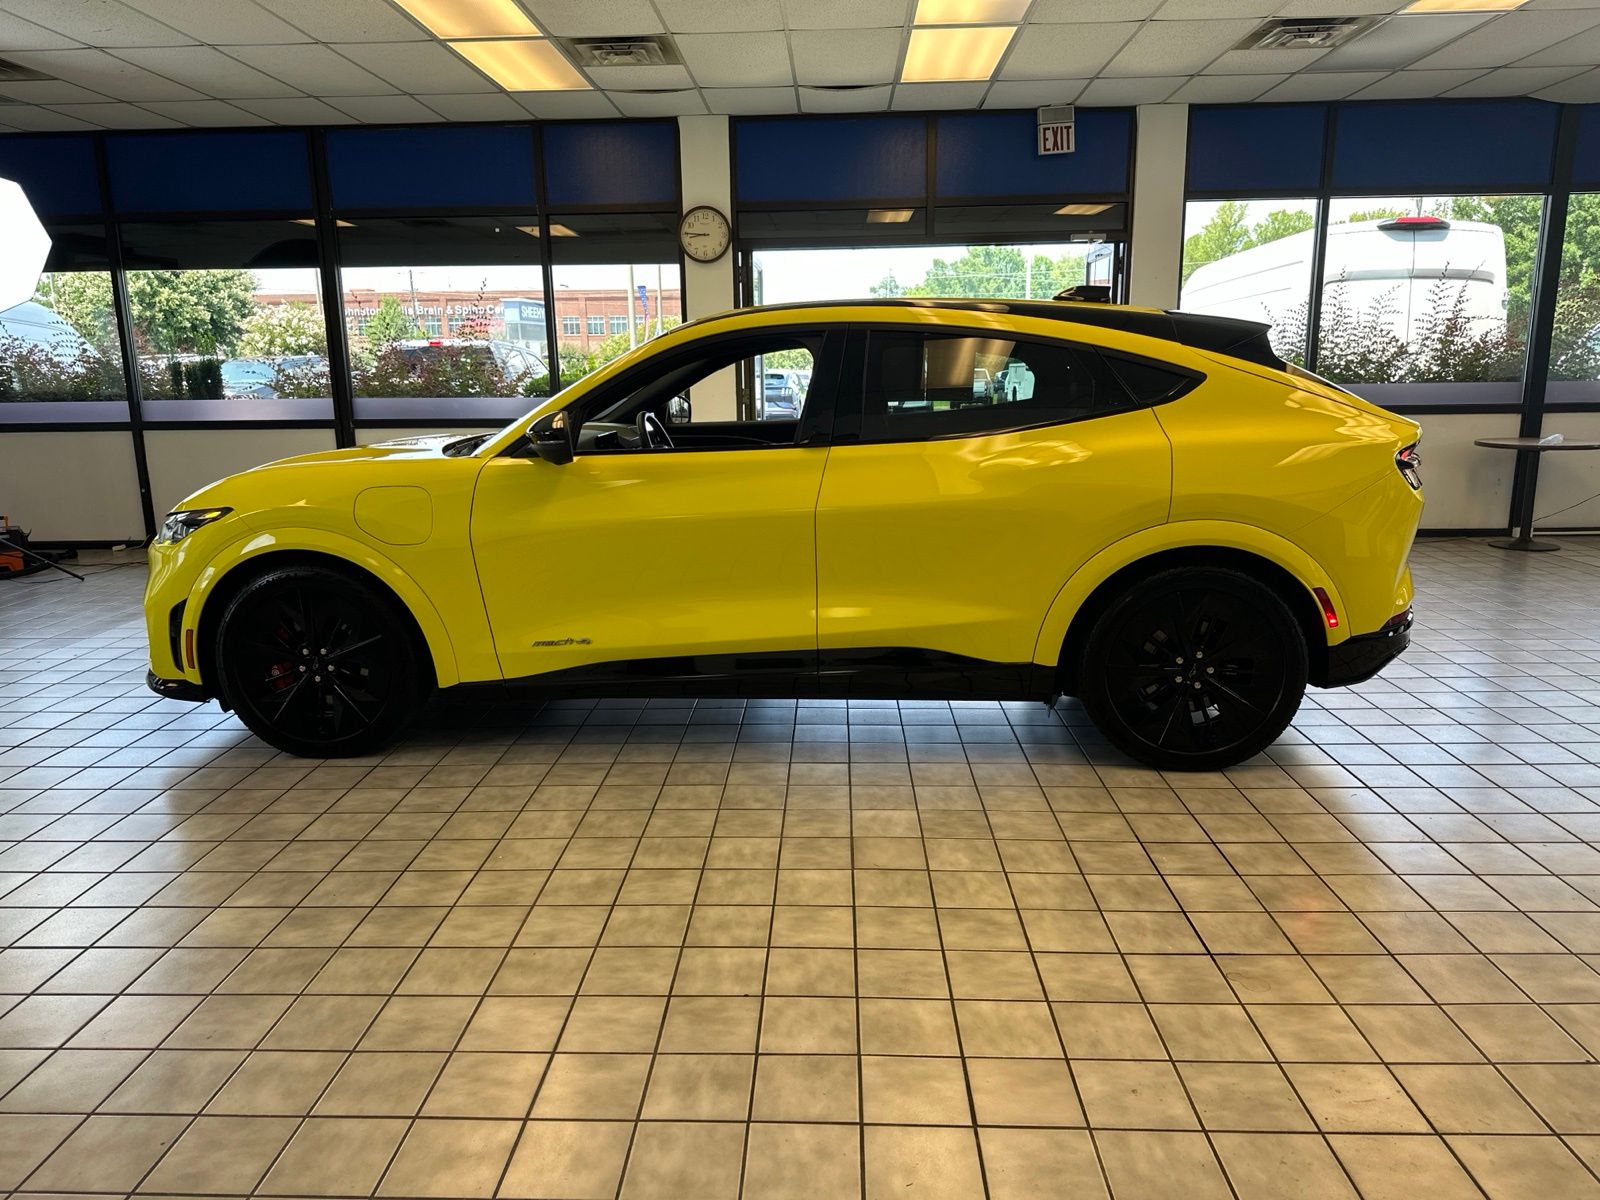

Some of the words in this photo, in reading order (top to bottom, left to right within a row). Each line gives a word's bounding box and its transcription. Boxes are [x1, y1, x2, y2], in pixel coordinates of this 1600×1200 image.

[1042, 125, 1072, 152] EXIT
[416, 305, 443, 315] Brain
[446, 305, 453, 315] &
